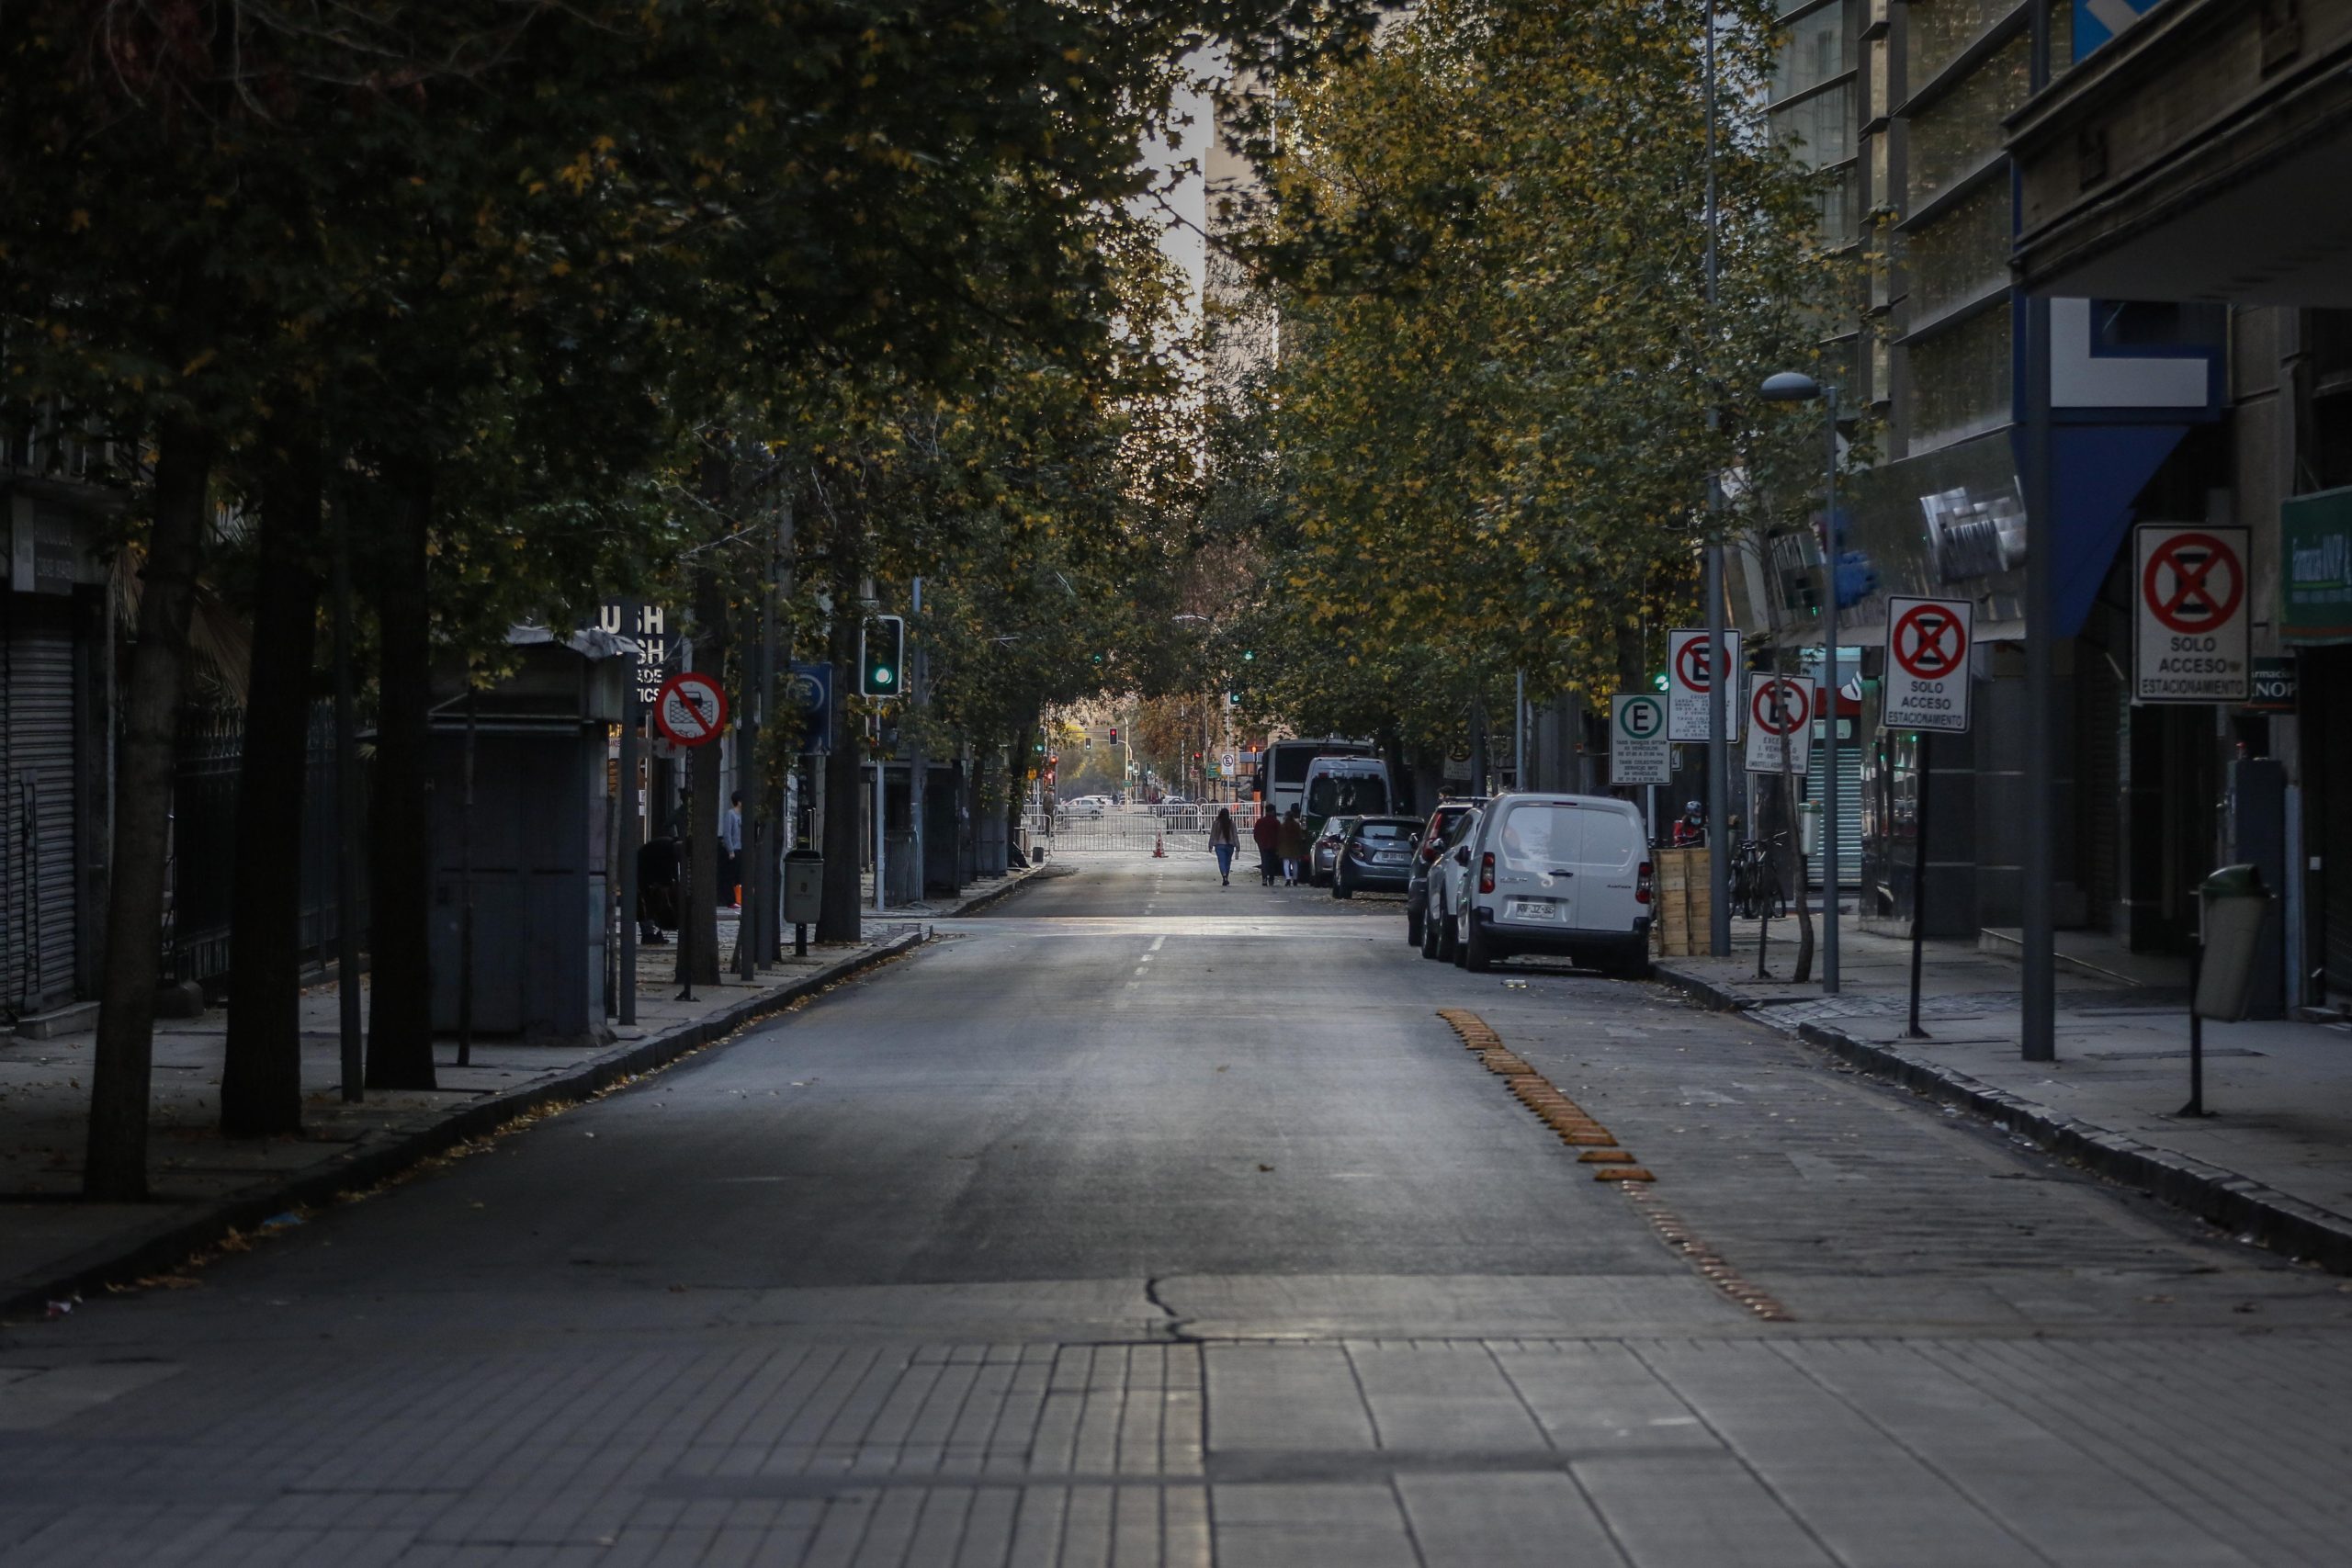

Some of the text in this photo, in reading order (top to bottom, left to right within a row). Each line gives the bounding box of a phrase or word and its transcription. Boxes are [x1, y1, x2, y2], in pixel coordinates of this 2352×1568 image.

[2171, 637, 2216, 652] SOLO
[2159, 659, 2227, 673] ACCESO
[1911, 681, 1944, 694] SOLO
[2142, 679, 2244, 694] ESTACIONAMIENTO
[1901, 696, 1951, 710] ACCESO
[1634, 705, 1649, 731] E
[1888, 711, 1962, 727] ESTACIONAMIENTO
